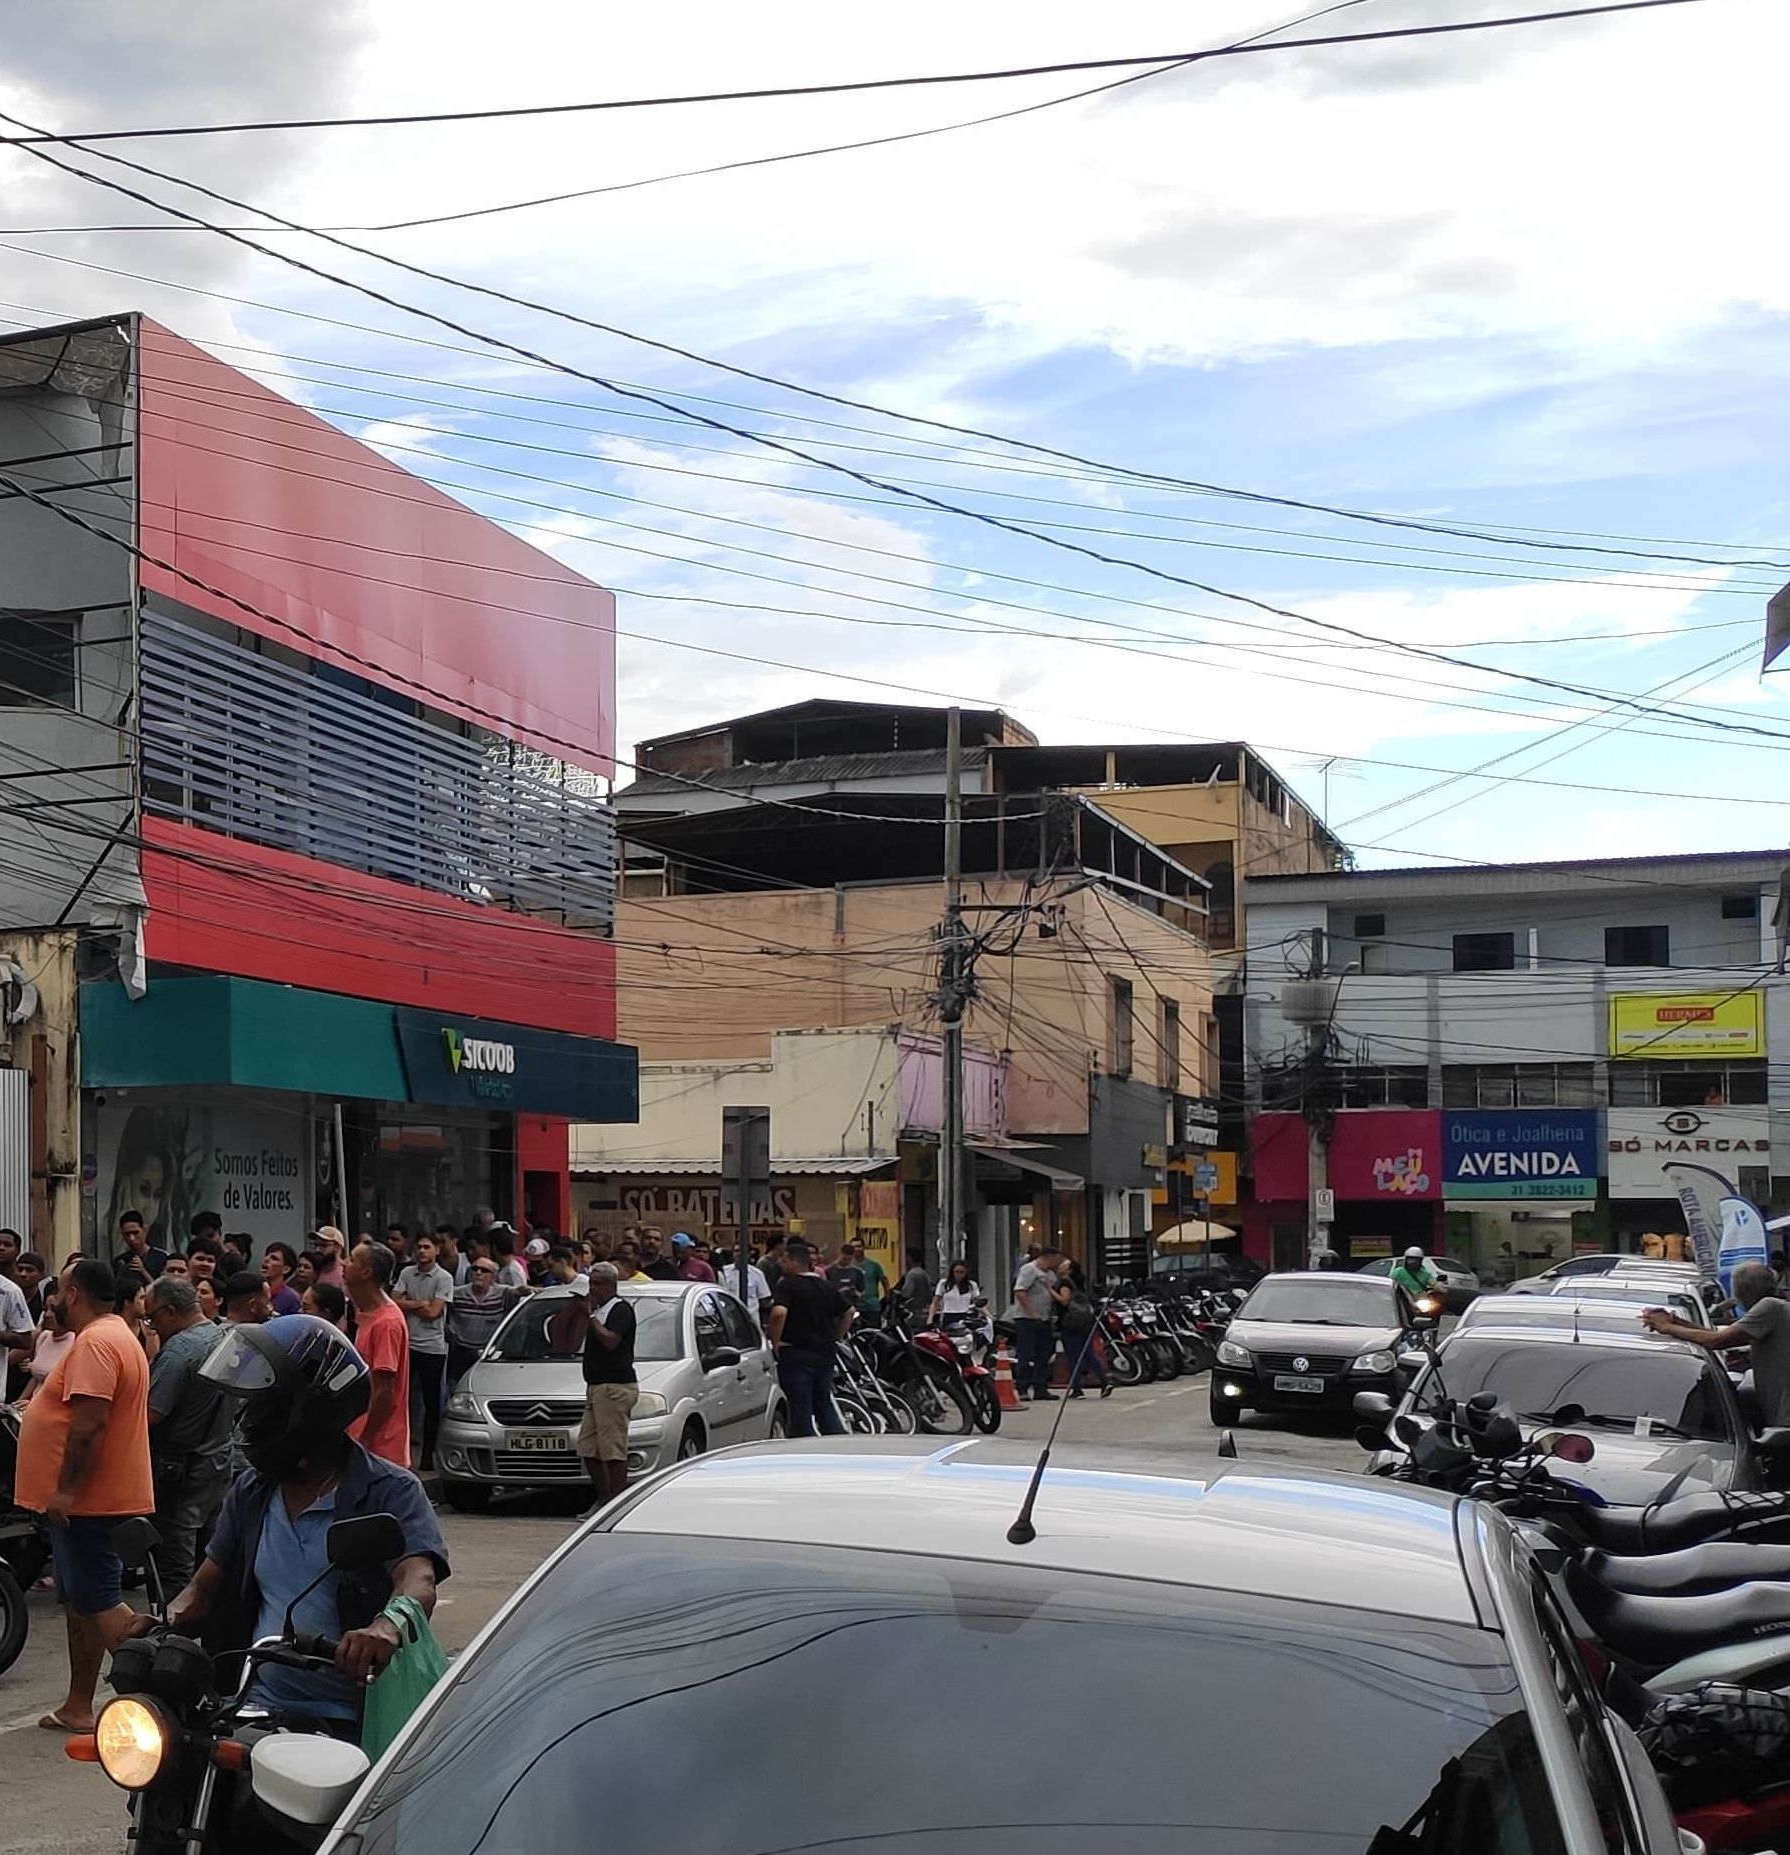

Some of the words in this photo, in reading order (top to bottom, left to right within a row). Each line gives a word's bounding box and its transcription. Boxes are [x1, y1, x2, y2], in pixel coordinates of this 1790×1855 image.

[461, 1038, 515, 1074] SICOOB
[1451, 1120, 1491, 1143] Ótica
[1497, 1129, 1507, 1142] e
[1512, 1124, 1585, 1143] Joalheria
[1608, 1135, 1641, 1152] SÓ
[1654, 1139, 1771, 1153] MARCAS
[214, 1147, 258, 1176] Somos
[261, 1150, 298, 1177] Feitos
[1457, 1151, 1581, 1176] AVENIDA
[223, 1182, 241, 1210] de
[243, 1182, 294, 1211] Valores.
[1511, 1185, 1524, 1196] 31
[1678, 1186, 1701, 1217] ROTA
